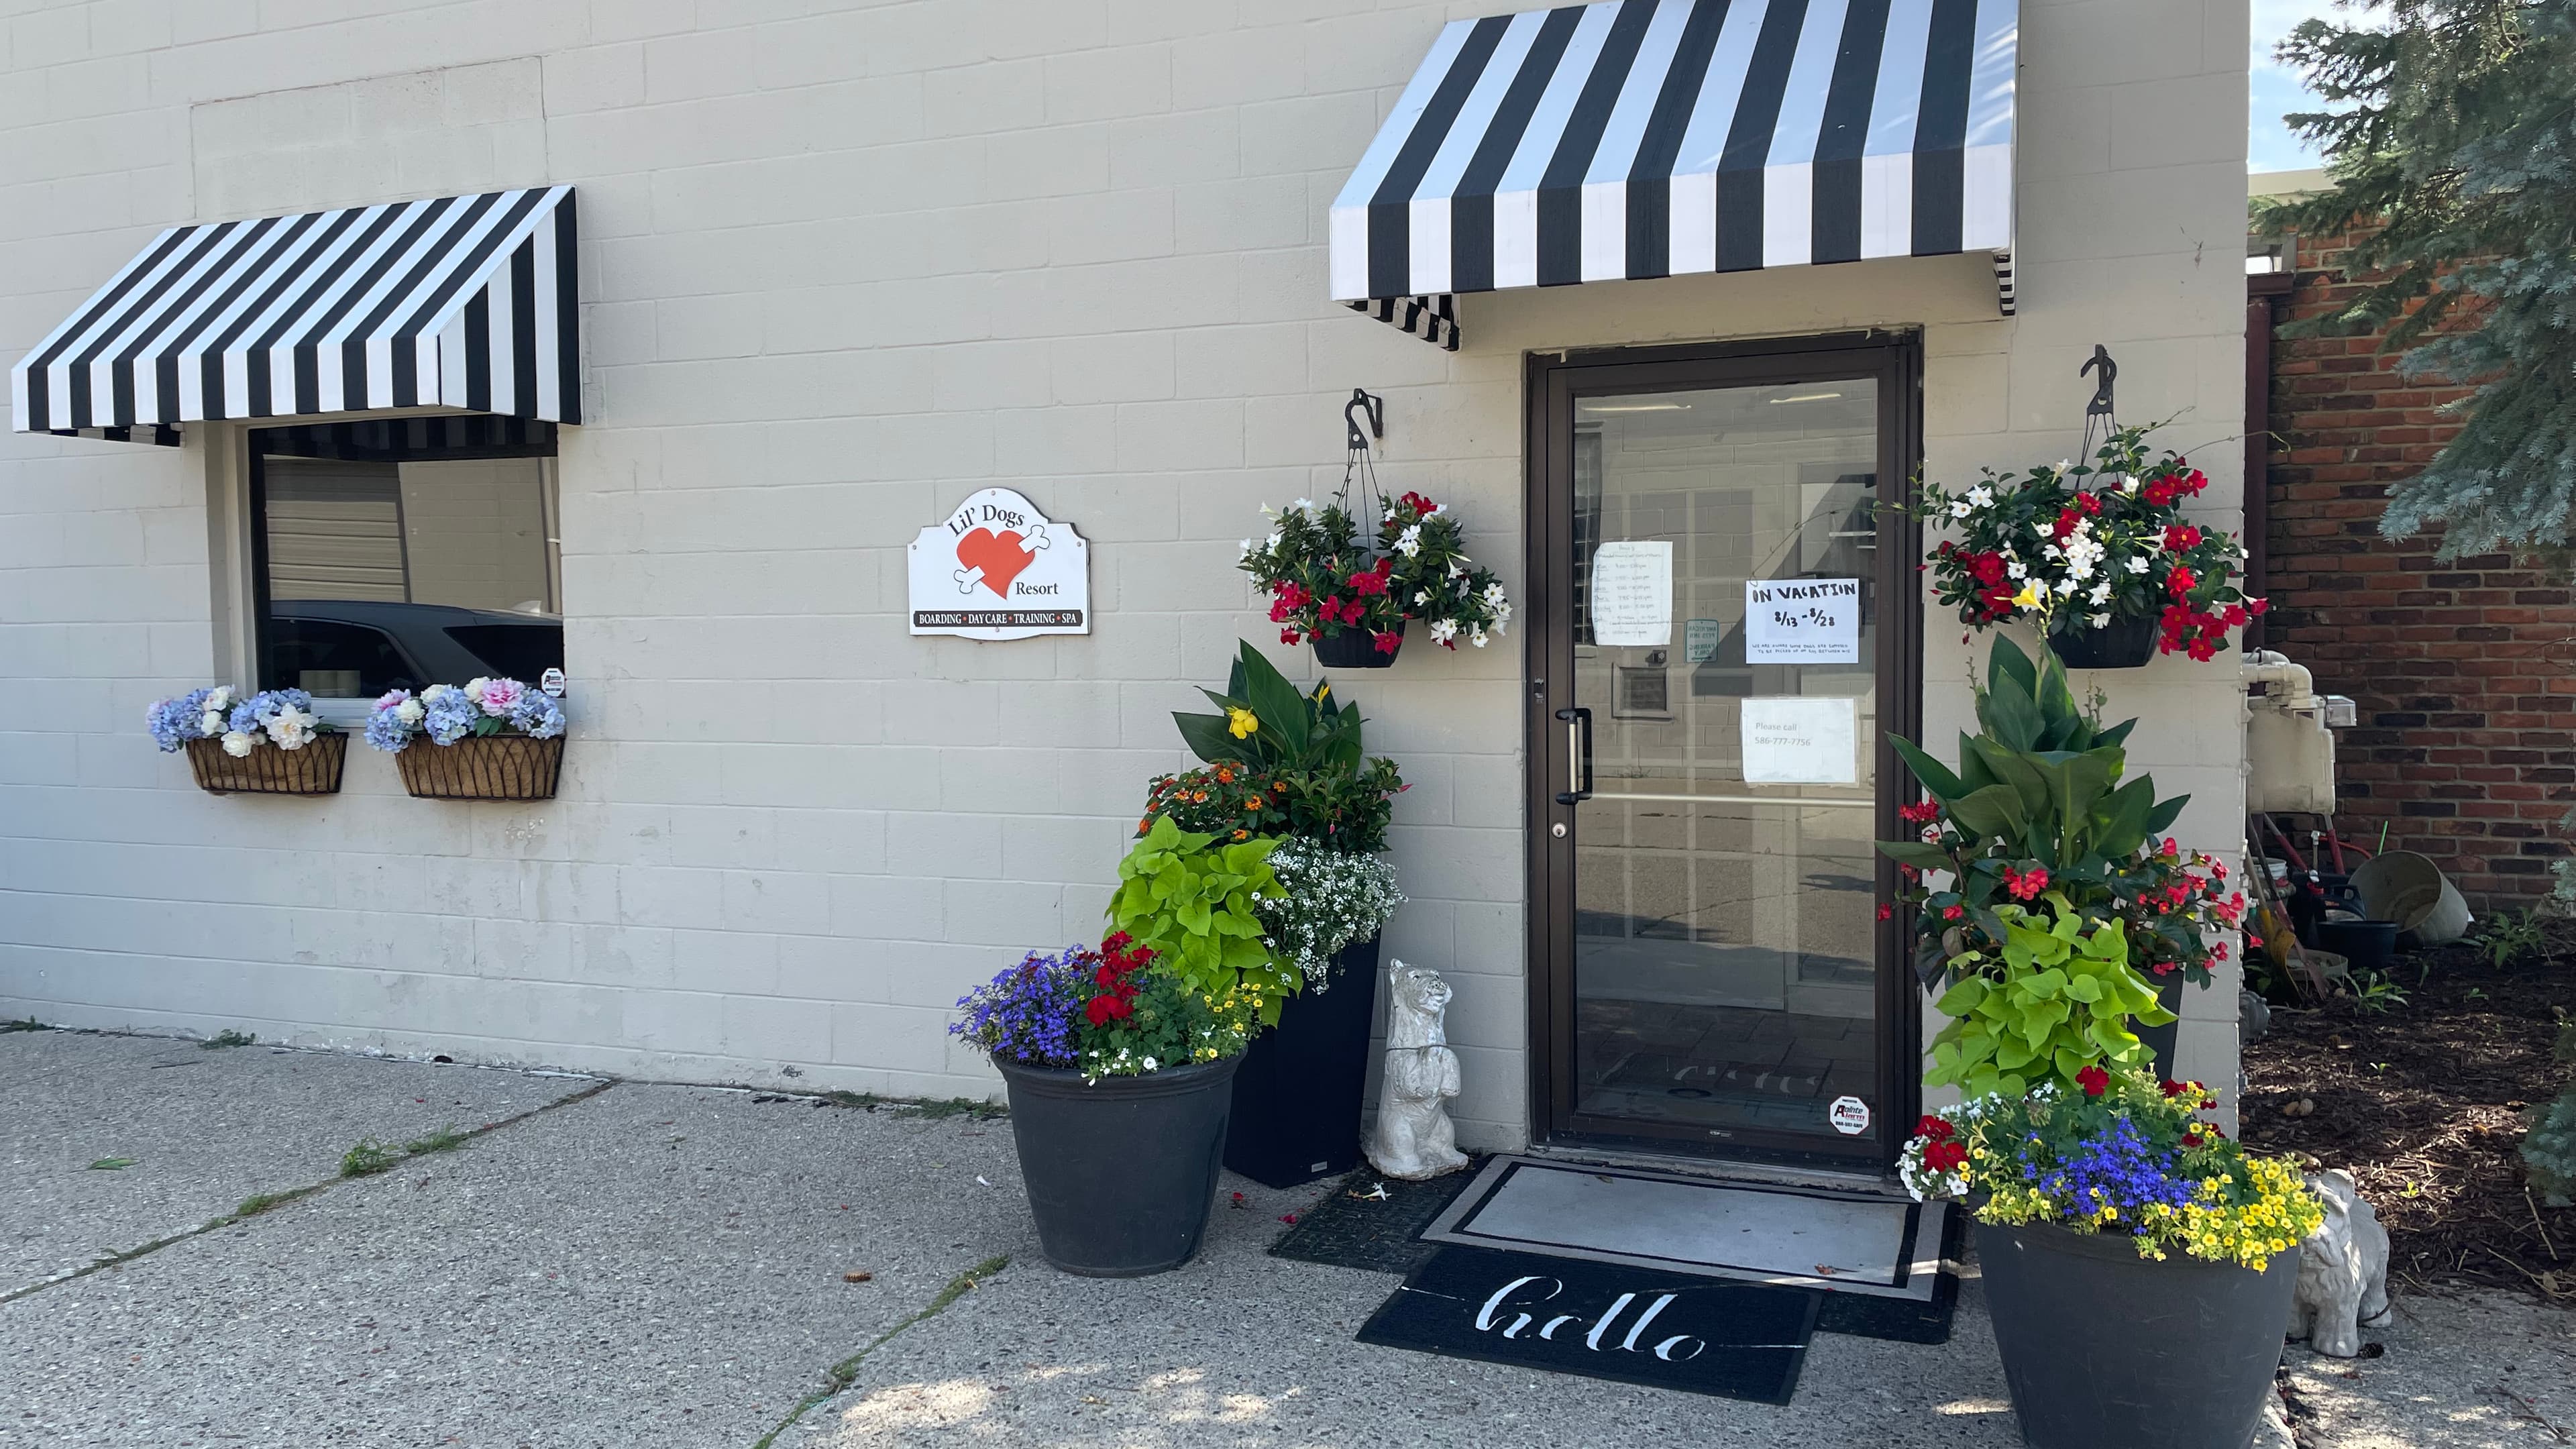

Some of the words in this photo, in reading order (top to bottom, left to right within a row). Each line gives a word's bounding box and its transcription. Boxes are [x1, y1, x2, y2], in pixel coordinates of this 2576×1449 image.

[948, 507, 975, 537] Lil'
[982, 504, 1024, 528] Dogs
[1015, 582, 1059, 594] Resort
[1752, 589, 1772, 602] ON
[1776, 584, 1856, 599] VACATION
[919, 614, 962, 624] BOARDING
[1014, 613, 1055, 623] TRAINING
[1062, 613, 1077, 623] SPA
[1756, 722, 1781, 731] Please
[1783, 723, 1797, 731] call
[1754, 737, 1811, 747] 586-777-7756
[1476, 1275, 1706, 1361] hello
